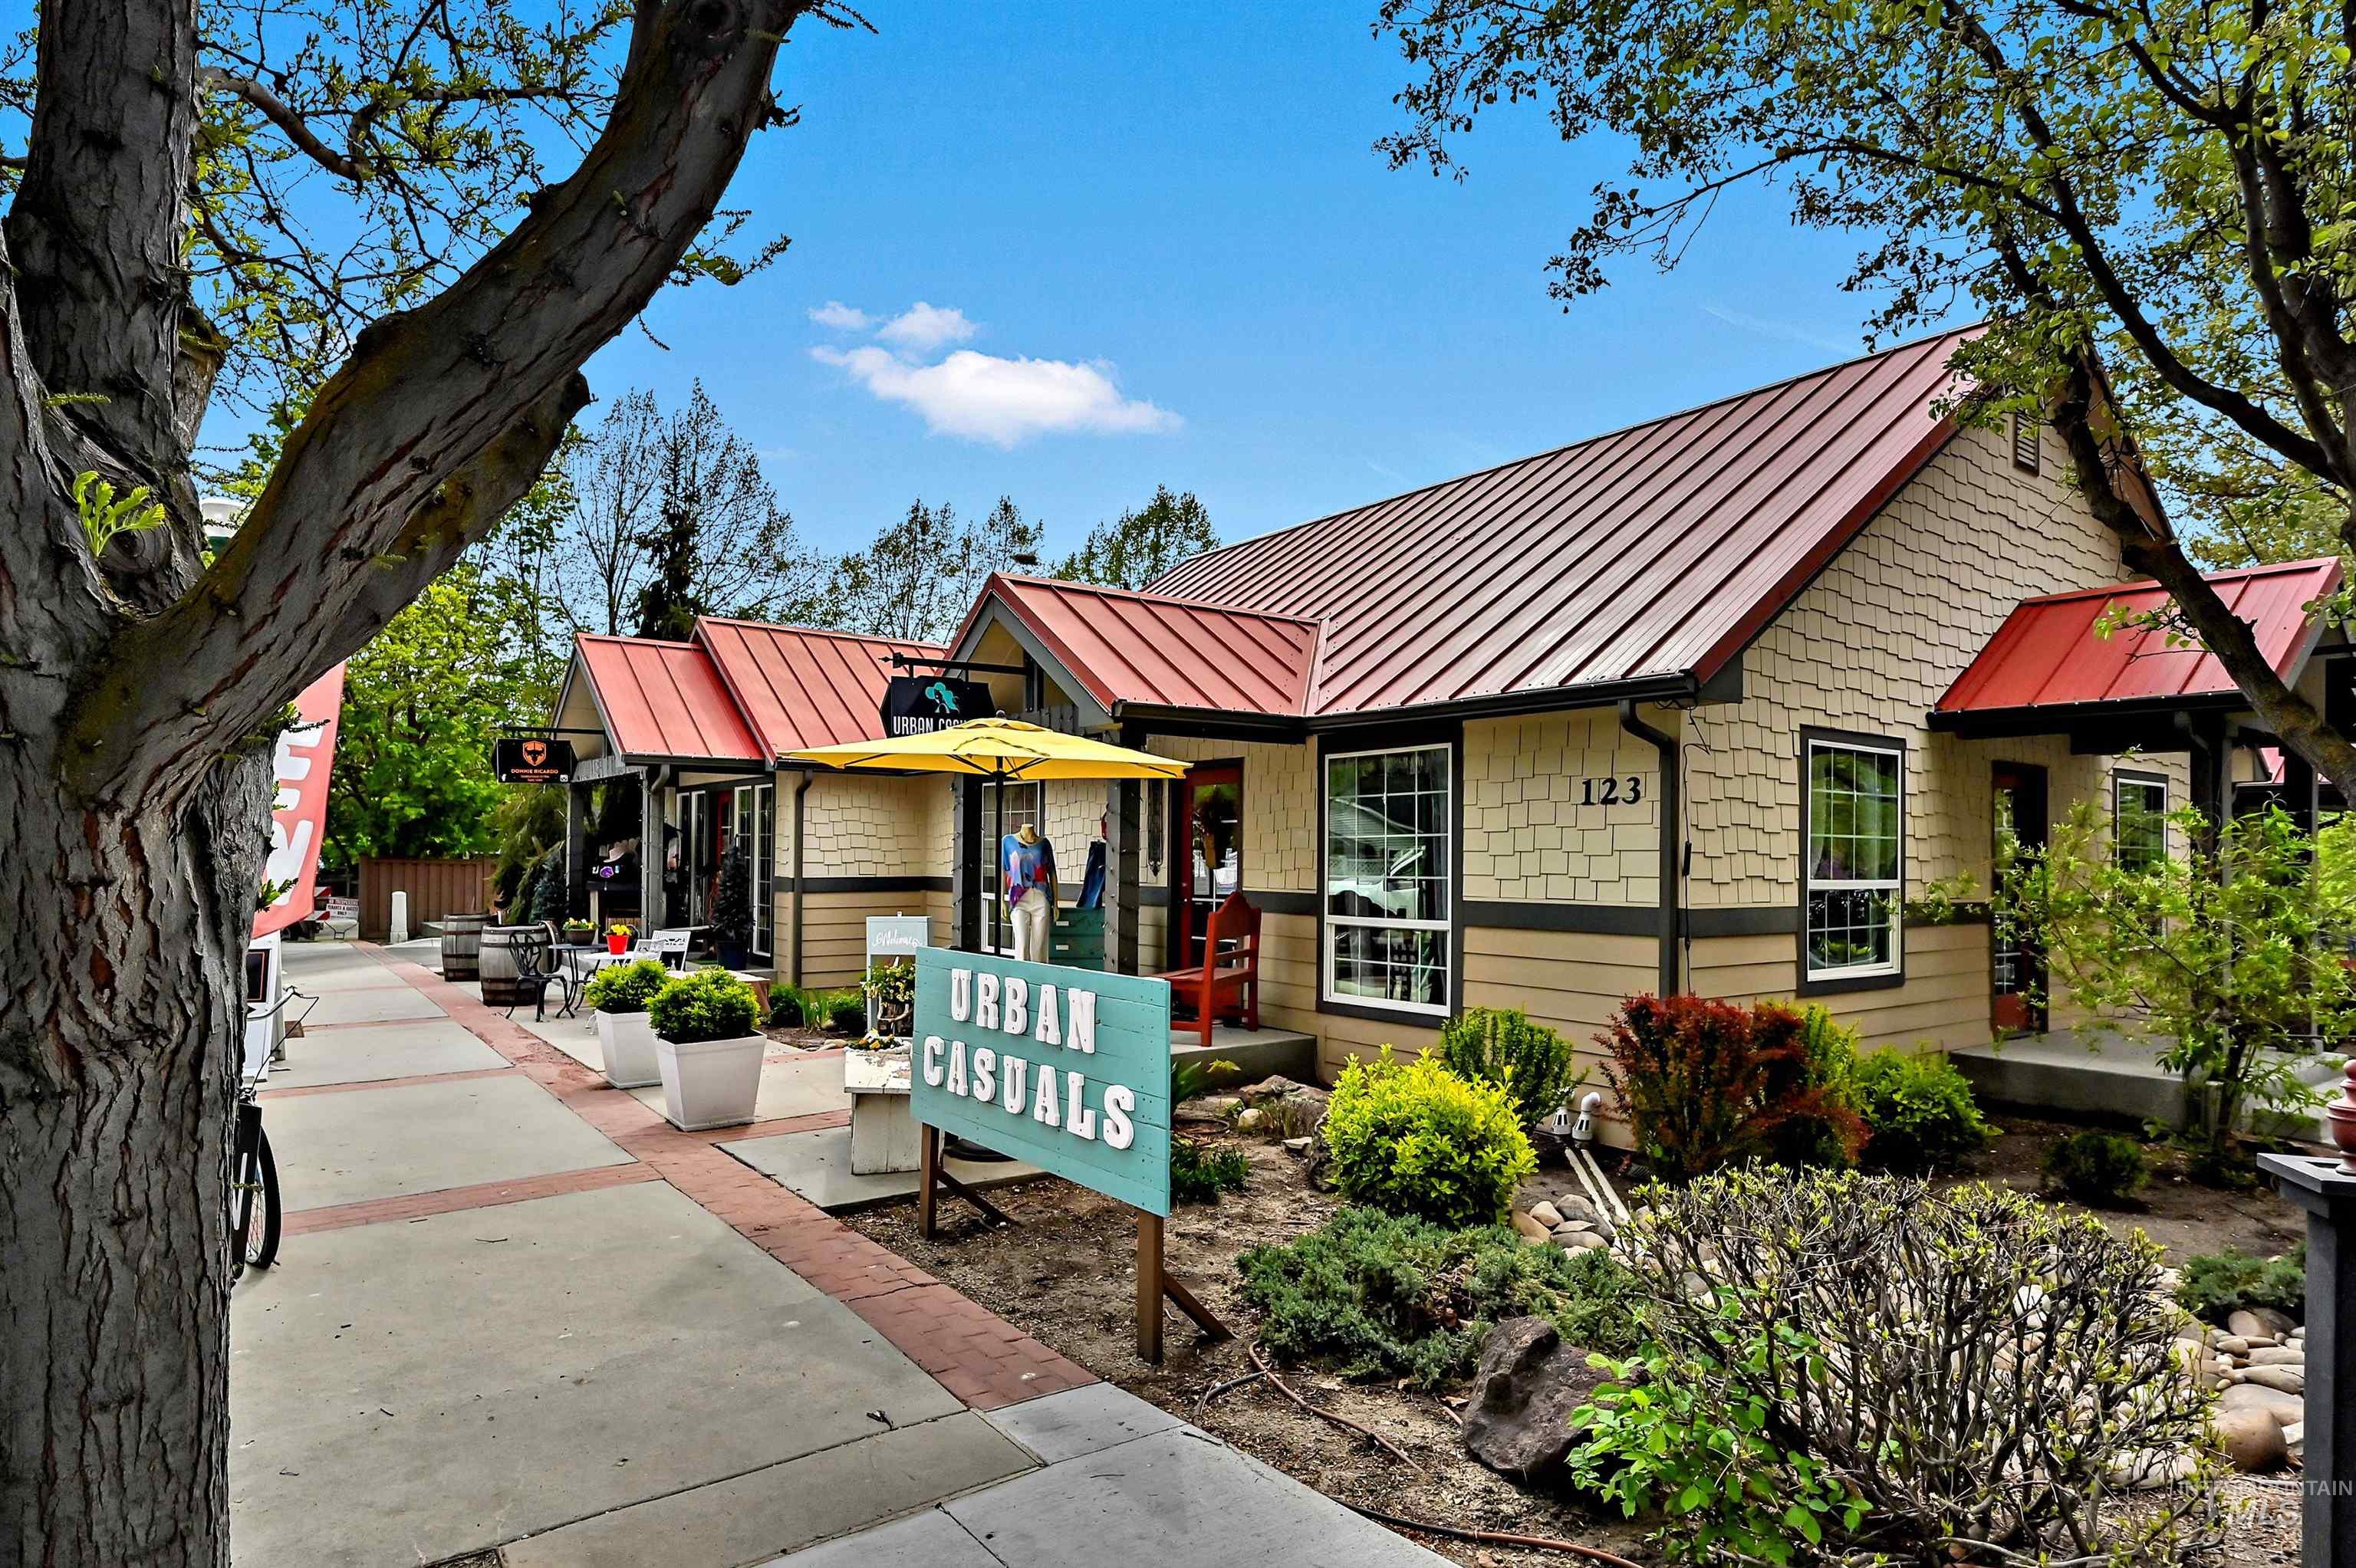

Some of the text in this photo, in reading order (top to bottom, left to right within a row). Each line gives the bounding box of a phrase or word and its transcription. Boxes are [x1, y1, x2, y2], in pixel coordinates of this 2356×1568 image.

[893, 715, 933, 735] URBAN
[1581, 776, 1641, 805] 123
[951, 968, 1097, 1054] URBAN
[923, 1036, 1135, 1149] CASUALS
